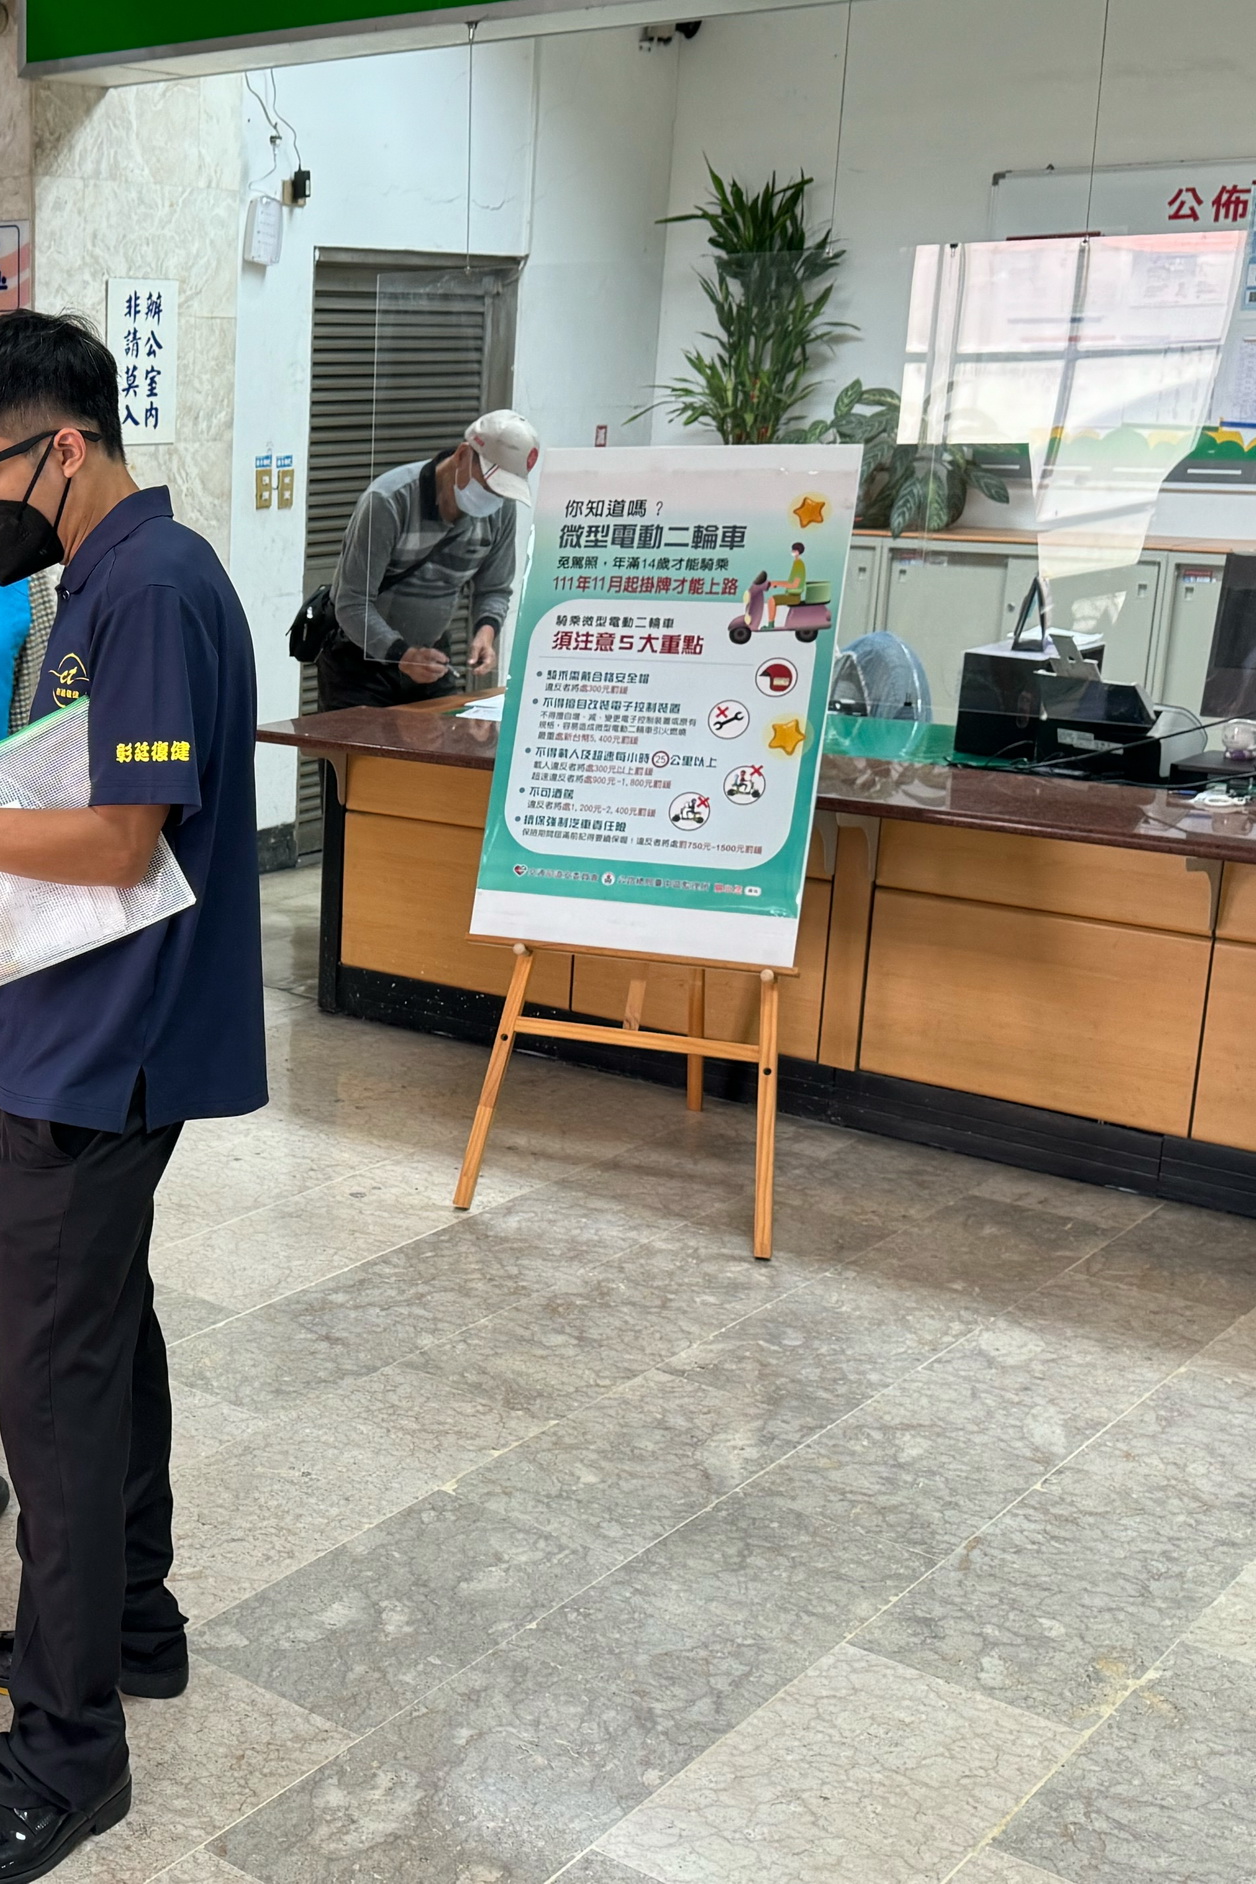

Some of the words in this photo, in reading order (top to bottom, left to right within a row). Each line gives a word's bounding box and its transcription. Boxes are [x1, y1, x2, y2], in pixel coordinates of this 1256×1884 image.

[1167, 184, 1251, 223] 公佈
[122, 290, 142, 426] 非請莫入
[558, 523, 747, 551] 微型電動二輪車
[552, 575, 739, 596] 111年11月起掛牌才能上路
[555, 615, 674, 629] 騎乘微型電動二輪車
[551, 631, 704, 656] 須注意5大重點
